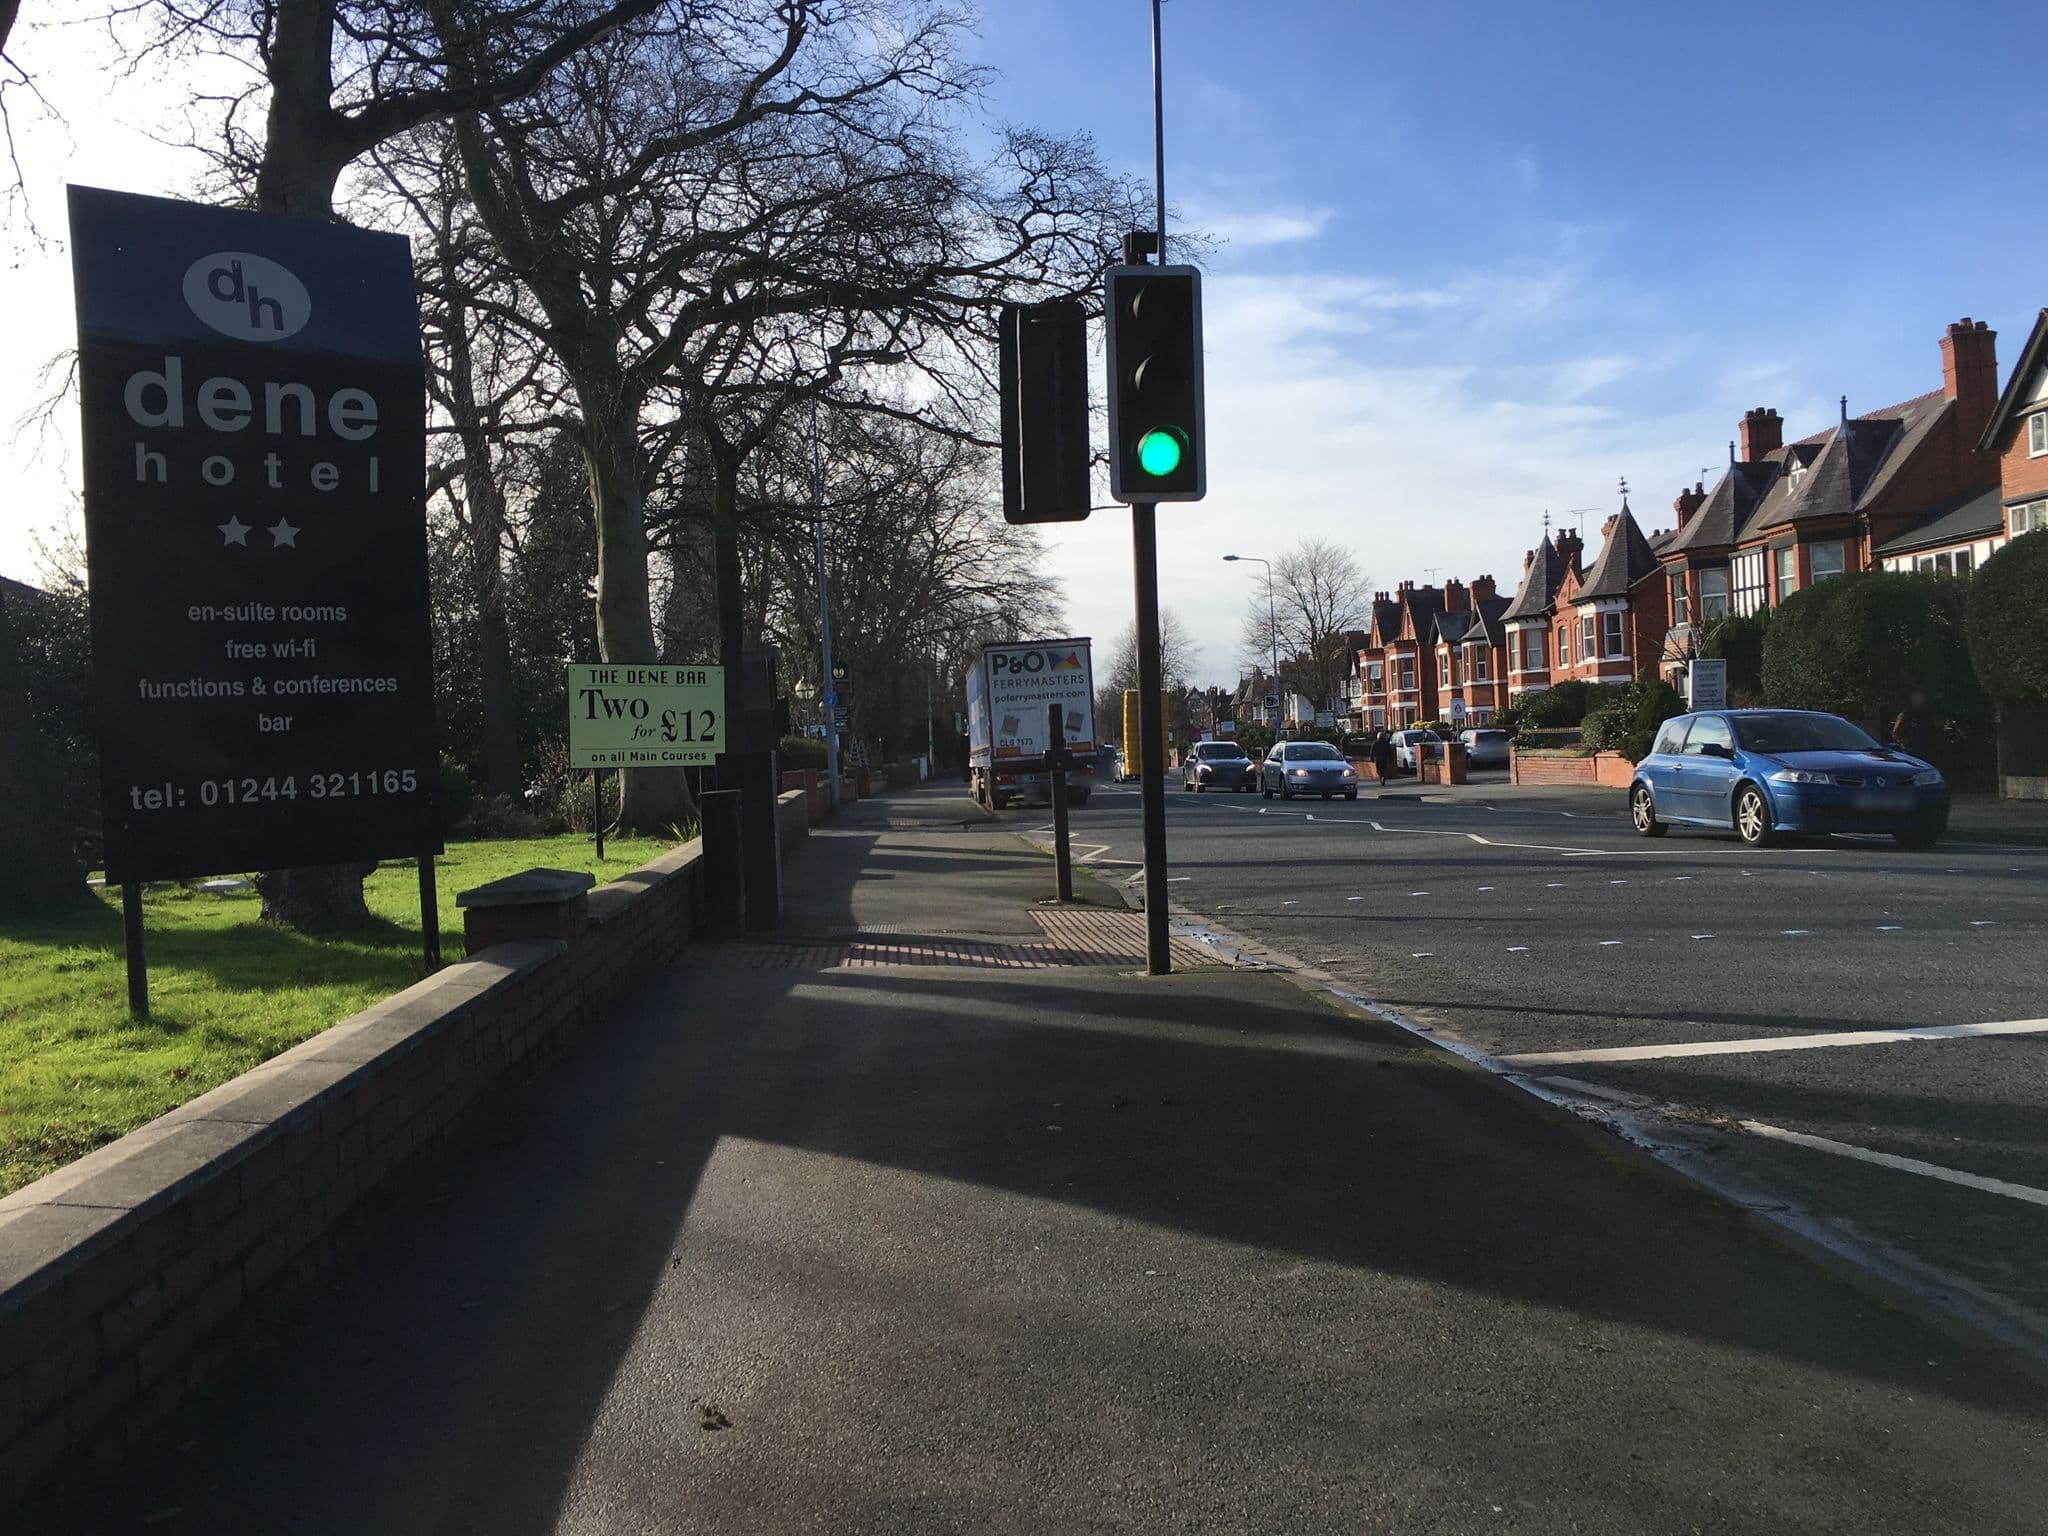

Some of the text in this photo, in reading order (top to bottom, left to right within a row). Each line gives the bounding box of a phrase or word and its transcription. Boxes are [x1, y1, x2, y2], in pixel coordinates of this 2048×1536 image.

[206, 259, 285, 331] dh
[123, 355, 379, 441] dene
[134, 442, 379, 493] hotel
[187, 602, 348, 622] en-suite rooms
[225, 639, 317, 659] free wi-fi
[991, 650, 1045, 675] P&O
[138, 675, 398, 699] functions & conferences
[589, 669, 707, 685] THE DENE BAR
[993, 674, 1085, 689] FERRYMASTERS
[994, 689, 1086, 704] poferrymasters.com
[258, 713, 294, 732] bar
[630, 709, 716, 743] for £12
[591, 751, 707, 762] on all Main Courses
[130, 769, 417, 811] tel: 01244 321165
